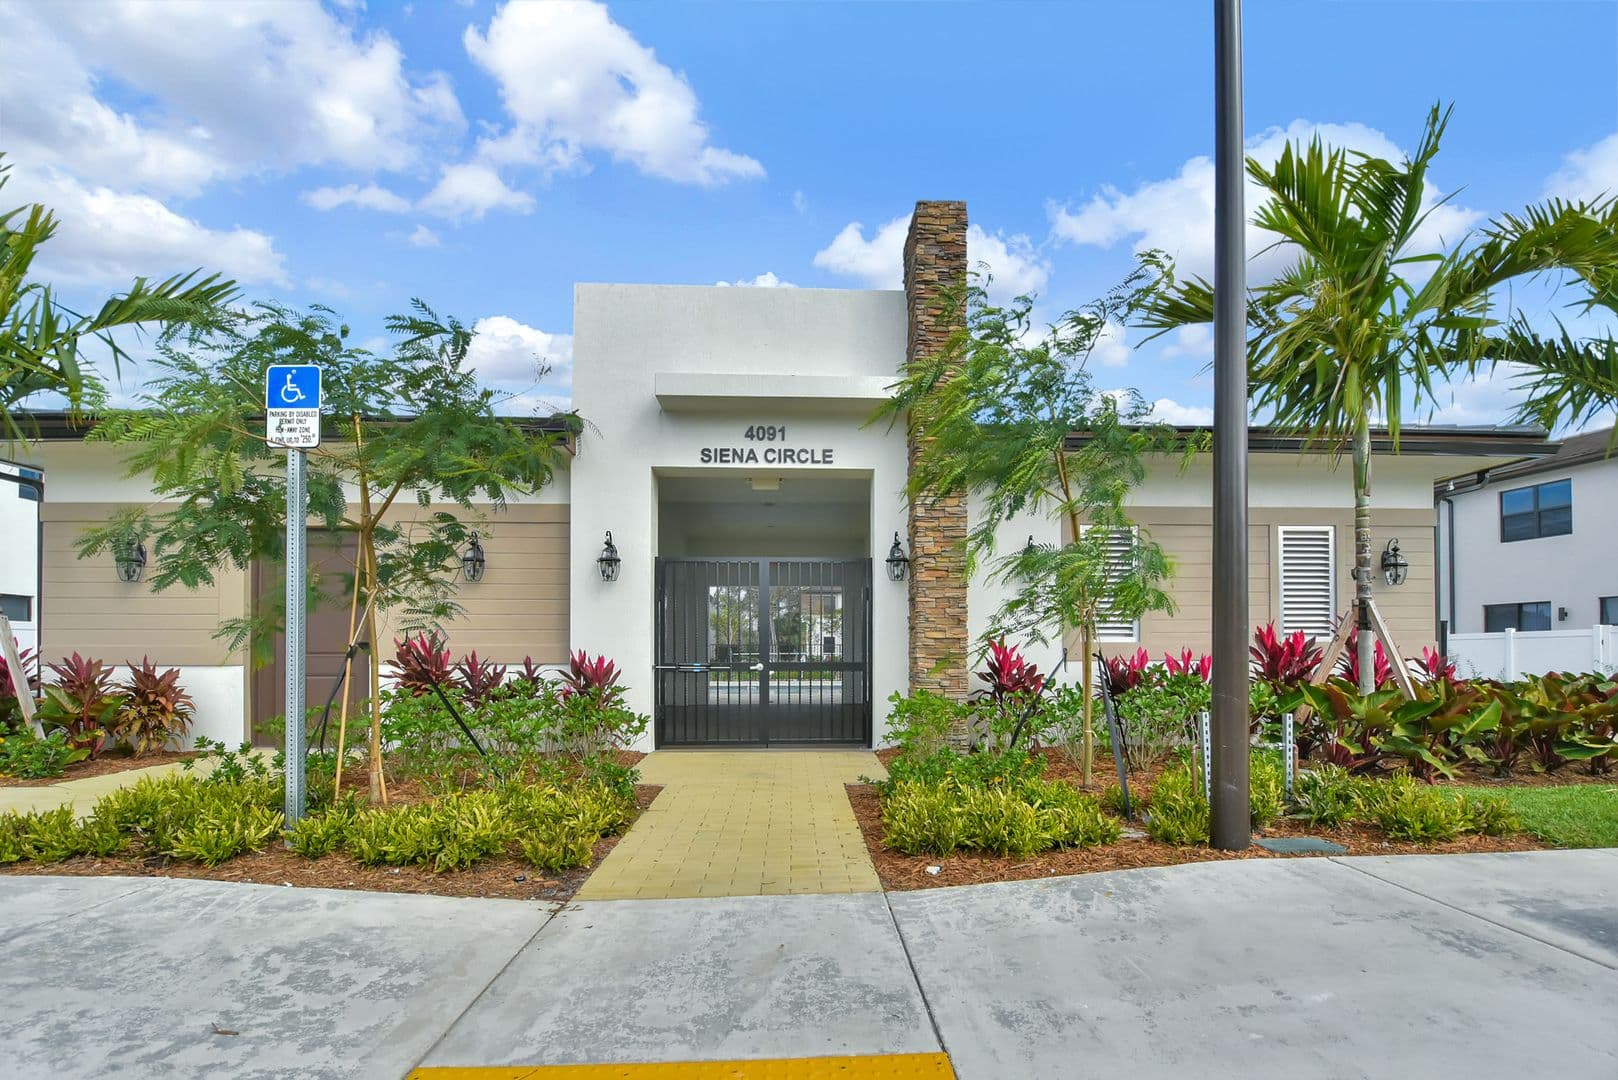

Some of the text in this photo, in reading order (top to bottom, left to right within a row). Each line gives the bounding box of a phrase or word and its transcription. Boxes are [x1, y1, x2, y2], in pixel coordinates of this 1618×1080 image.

[744, 425, 786, 441] 4091
[700, 447, 834, 464] SIENA CIRCLE
